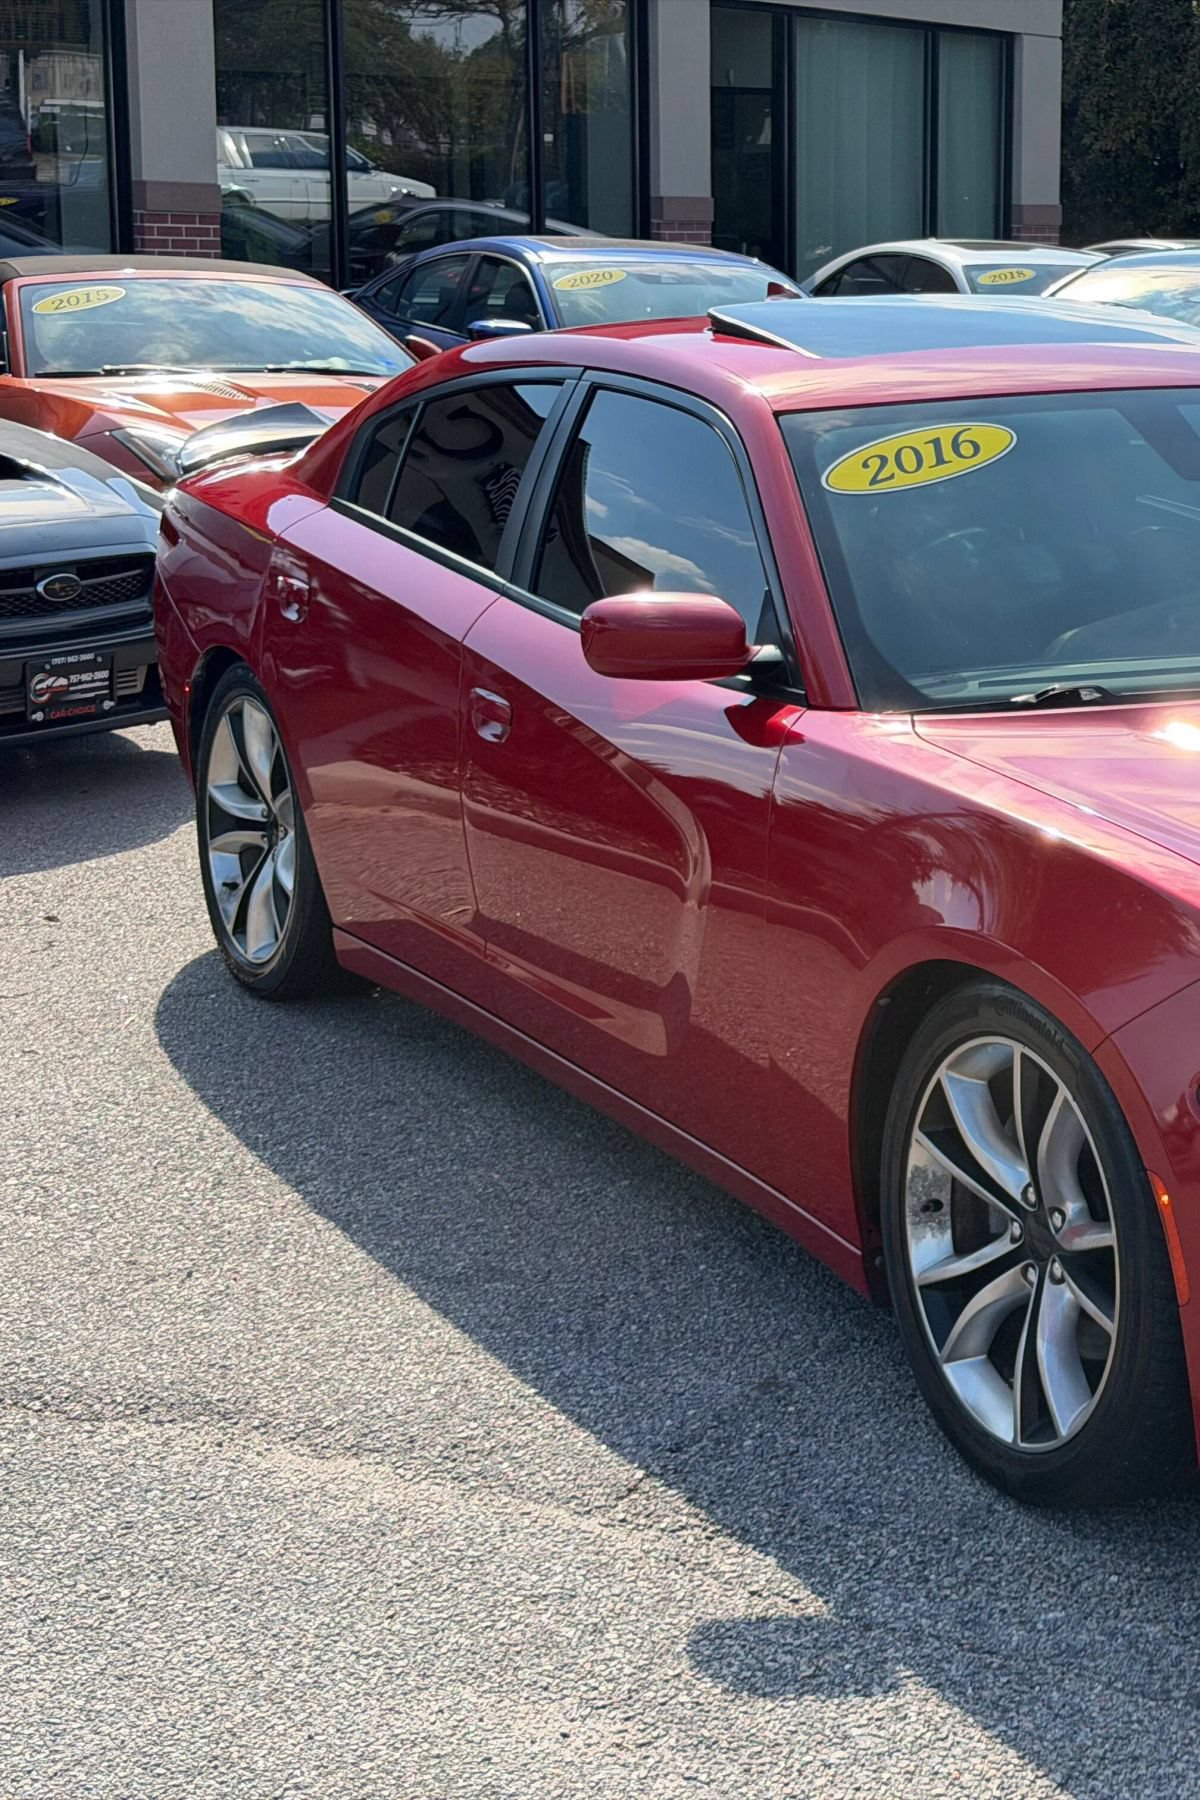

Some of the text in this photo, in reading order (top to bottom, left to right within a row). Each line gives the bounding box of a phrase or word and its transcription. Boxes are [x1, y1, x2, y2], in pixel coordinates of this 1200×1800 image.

[567, 271, 613, 288] 2020
[989, 269, 1026, 283] 2018
[51, 288, 109, 311] 2015
[861, 427, 981, 487] 2016
